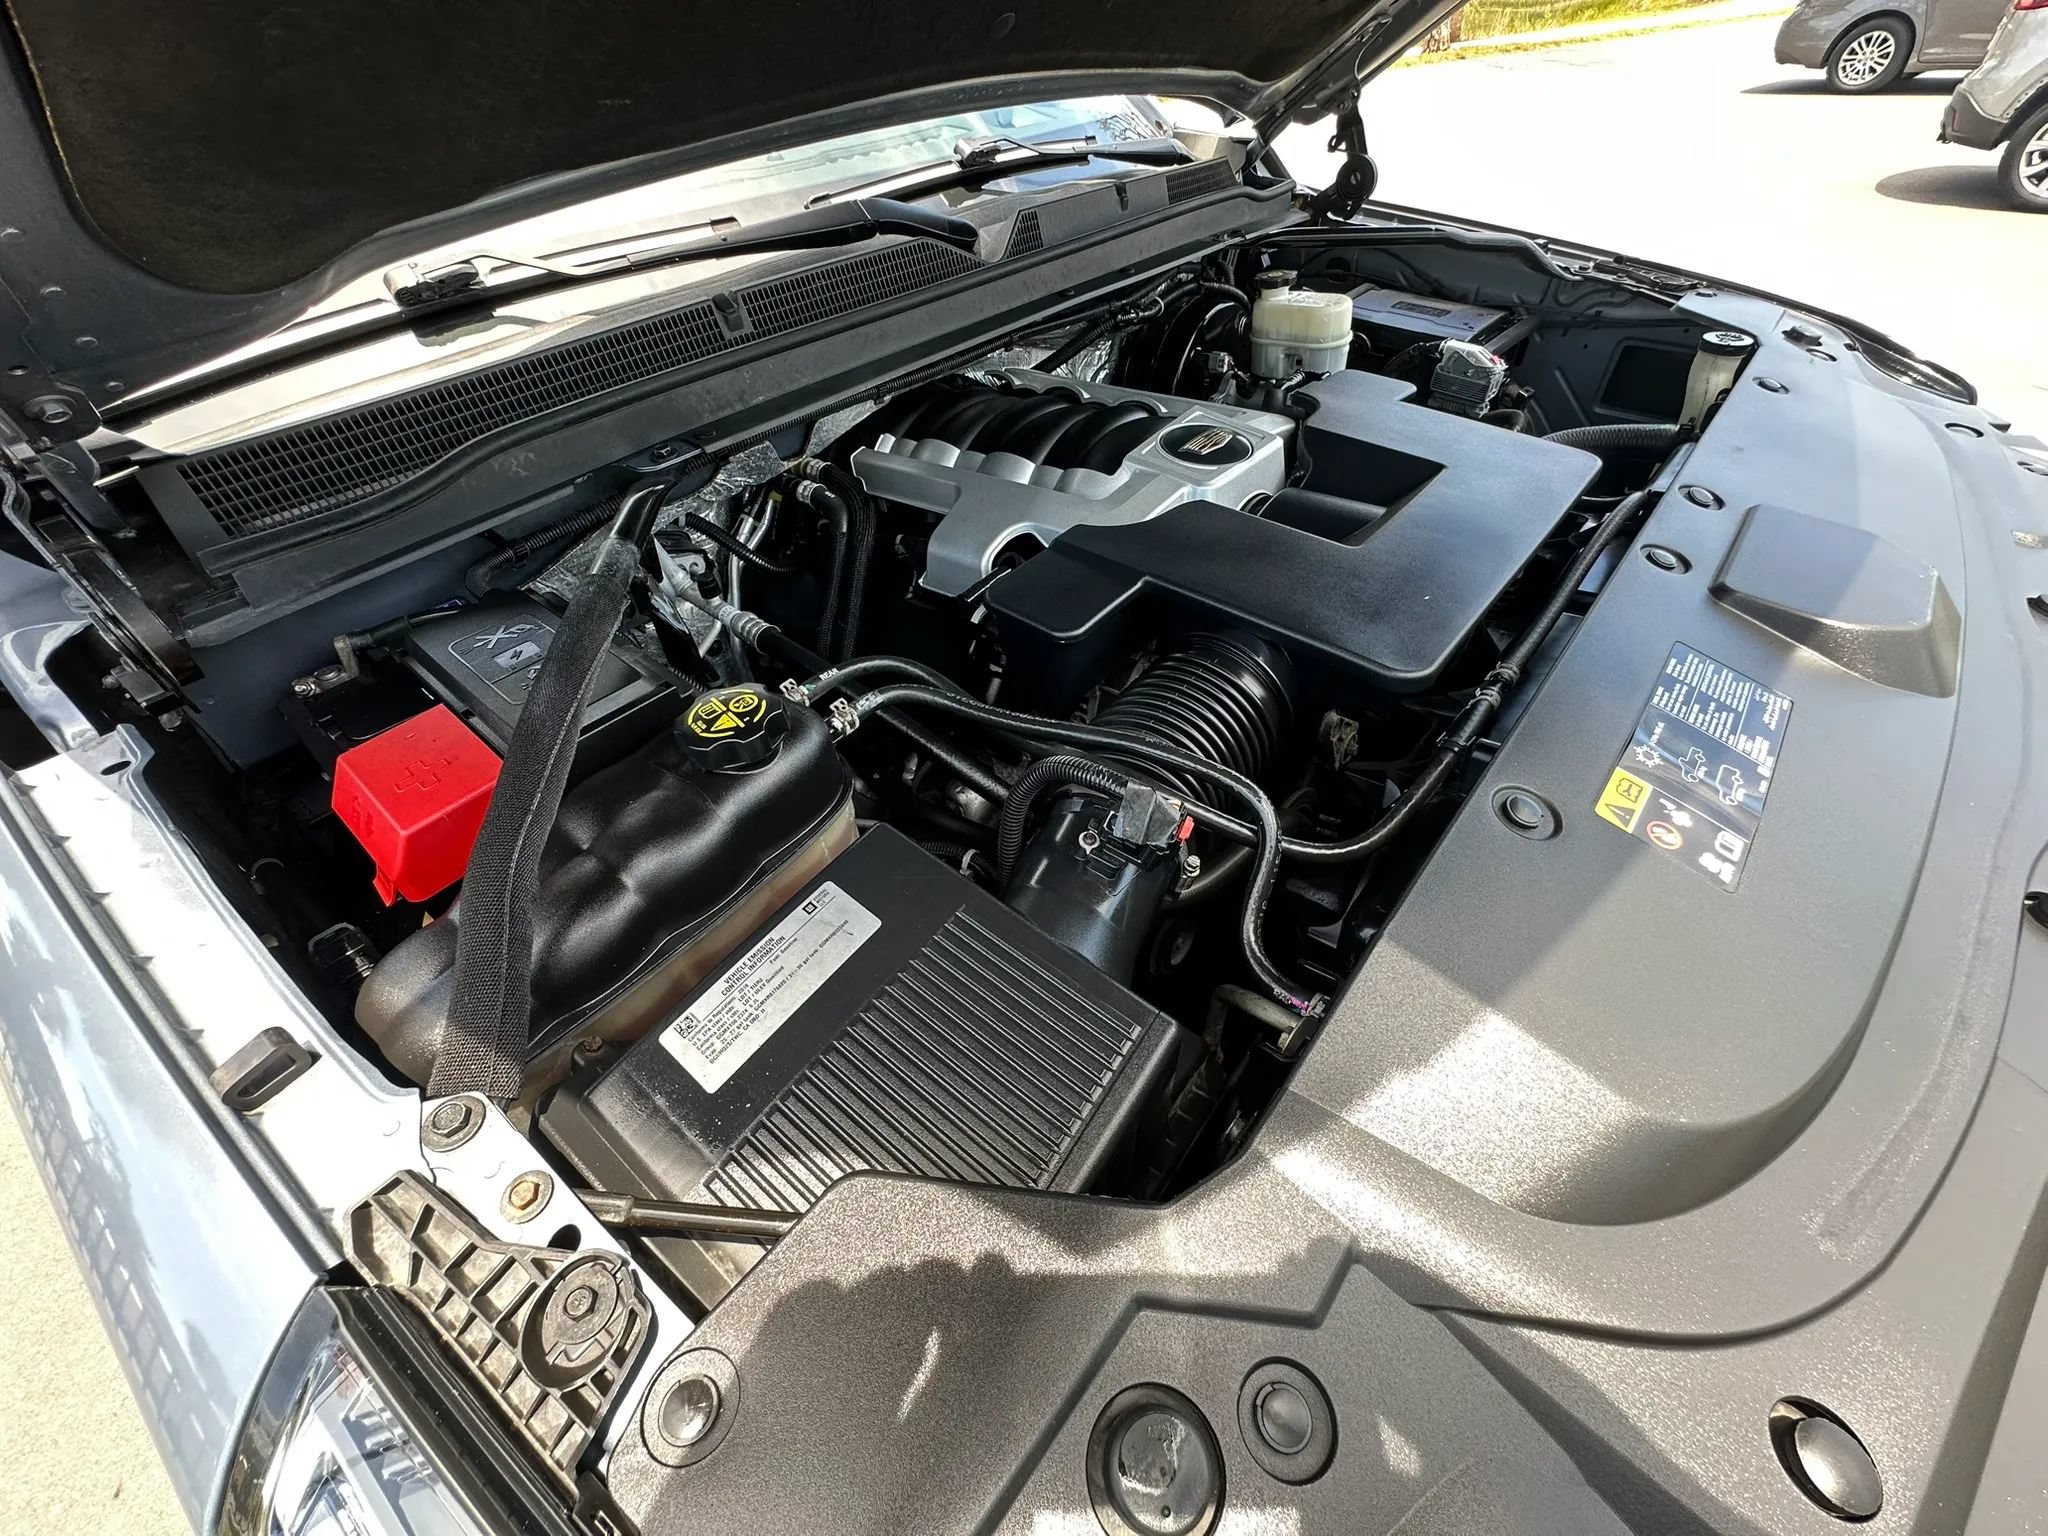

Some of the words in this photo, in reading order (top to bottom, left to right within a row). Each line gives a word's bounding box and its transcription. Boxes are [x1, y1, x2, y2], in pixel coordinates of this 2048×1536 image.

[818, 667, 840, 681] REAR
[720, 969, 749, 996] CONTROL
[747, 935, 785, 971] INFORMATION
[723, 960, 748, 984] VEHICLE
[747, 936, 774, 962] EMISSION
